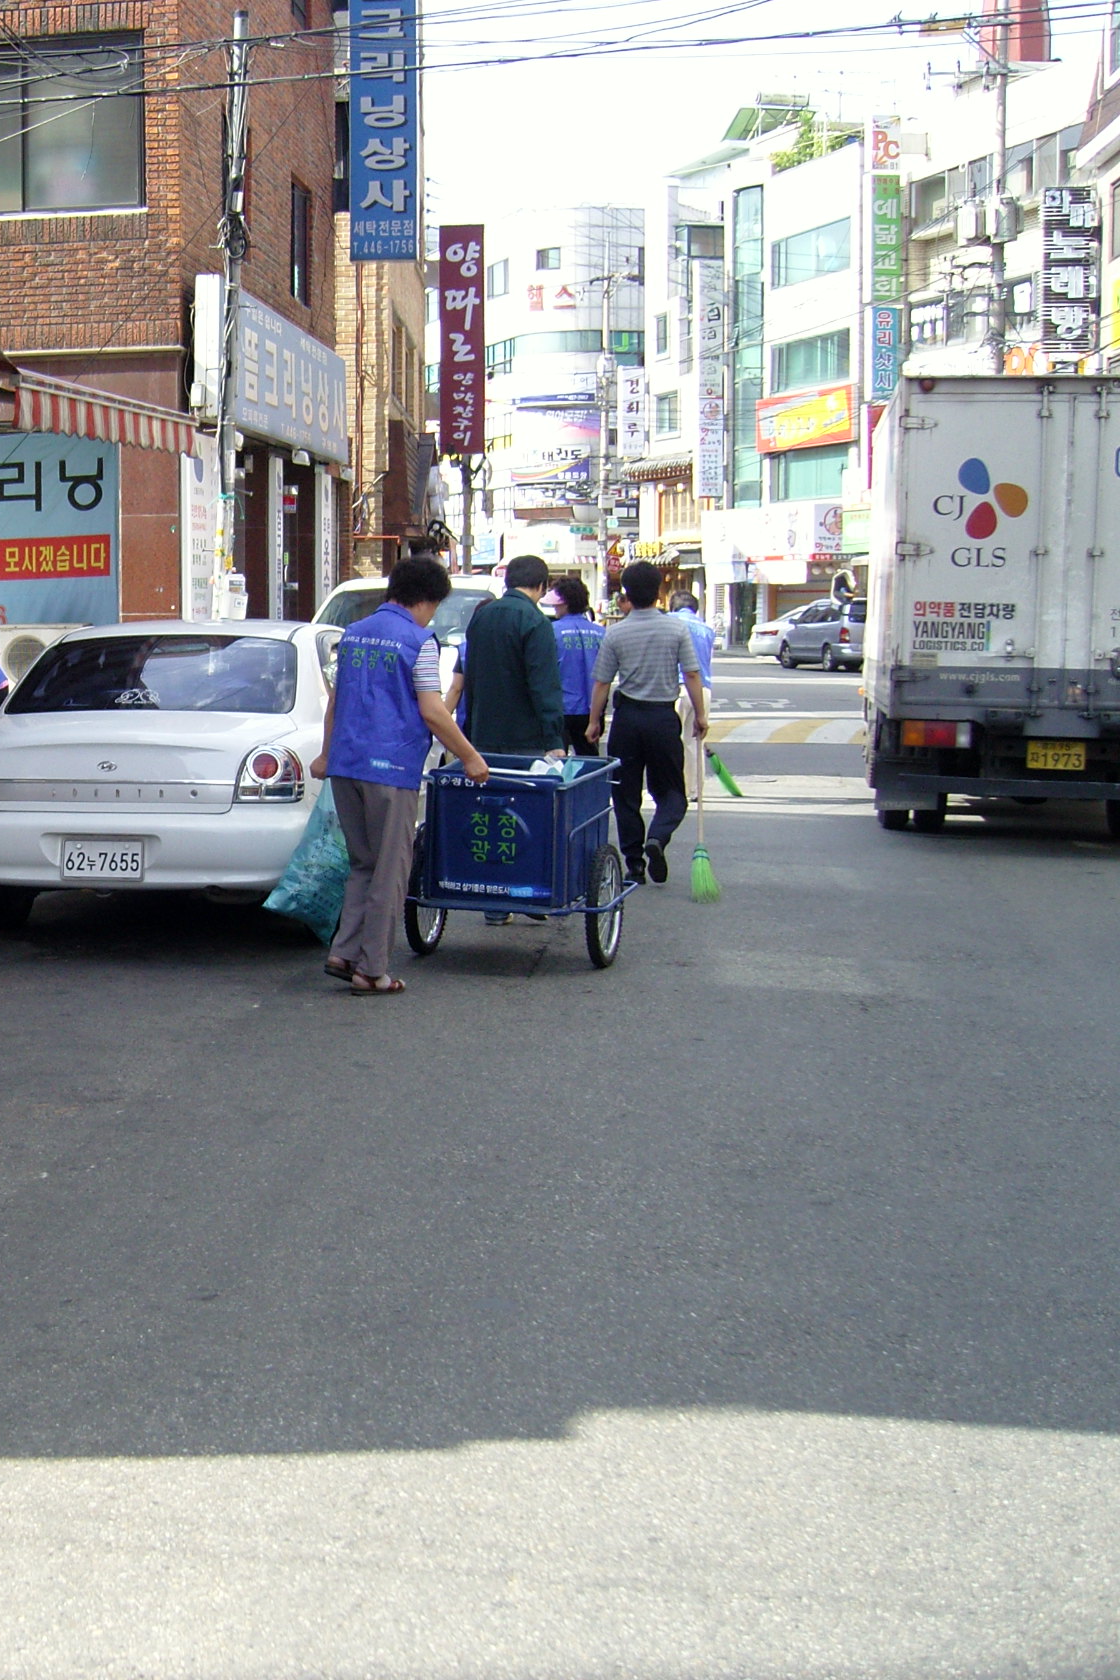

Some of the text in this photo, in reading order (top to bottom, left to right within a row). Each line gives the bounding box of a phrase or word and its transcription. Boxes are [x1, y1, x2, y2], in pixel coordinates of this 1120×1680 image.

[445, 241, 480, 363] 양따로
[933, 495, 966, 521] CJ
[5, 543, 105, 573] 모시겠습니다
[951, 547, 1007, 568] GLS
[914, 601, 1016, 620] 의약품 전담차량
[913, 621, 985, 640] YANGYANG
[939, 670, 1021, 684] www.cjgls.com
[65, 852, 140, 872] 62누7655
